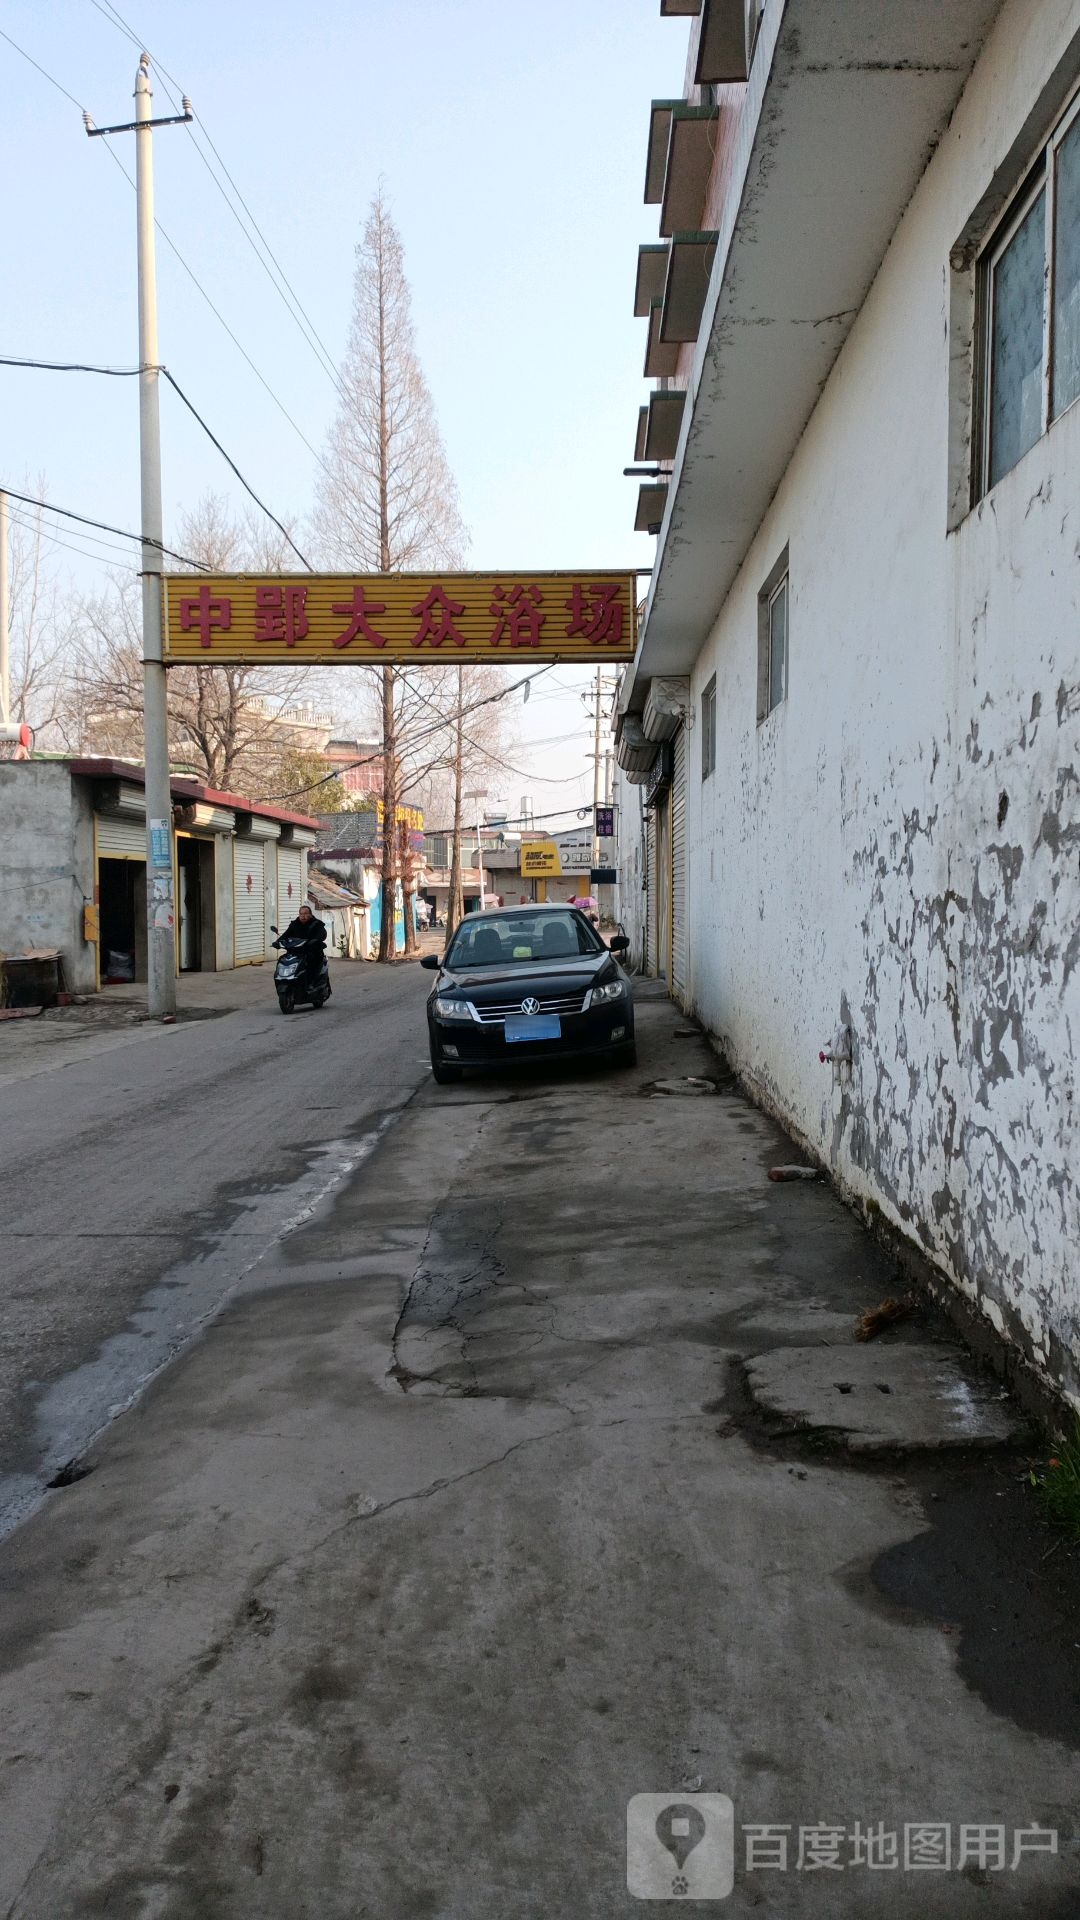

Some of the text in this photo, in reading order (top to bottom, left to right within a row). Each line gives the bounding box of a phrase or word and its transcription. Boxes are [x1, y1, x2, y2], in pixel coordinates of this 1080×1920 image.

[179, 585, 624, 648] 中郢大众浴场
